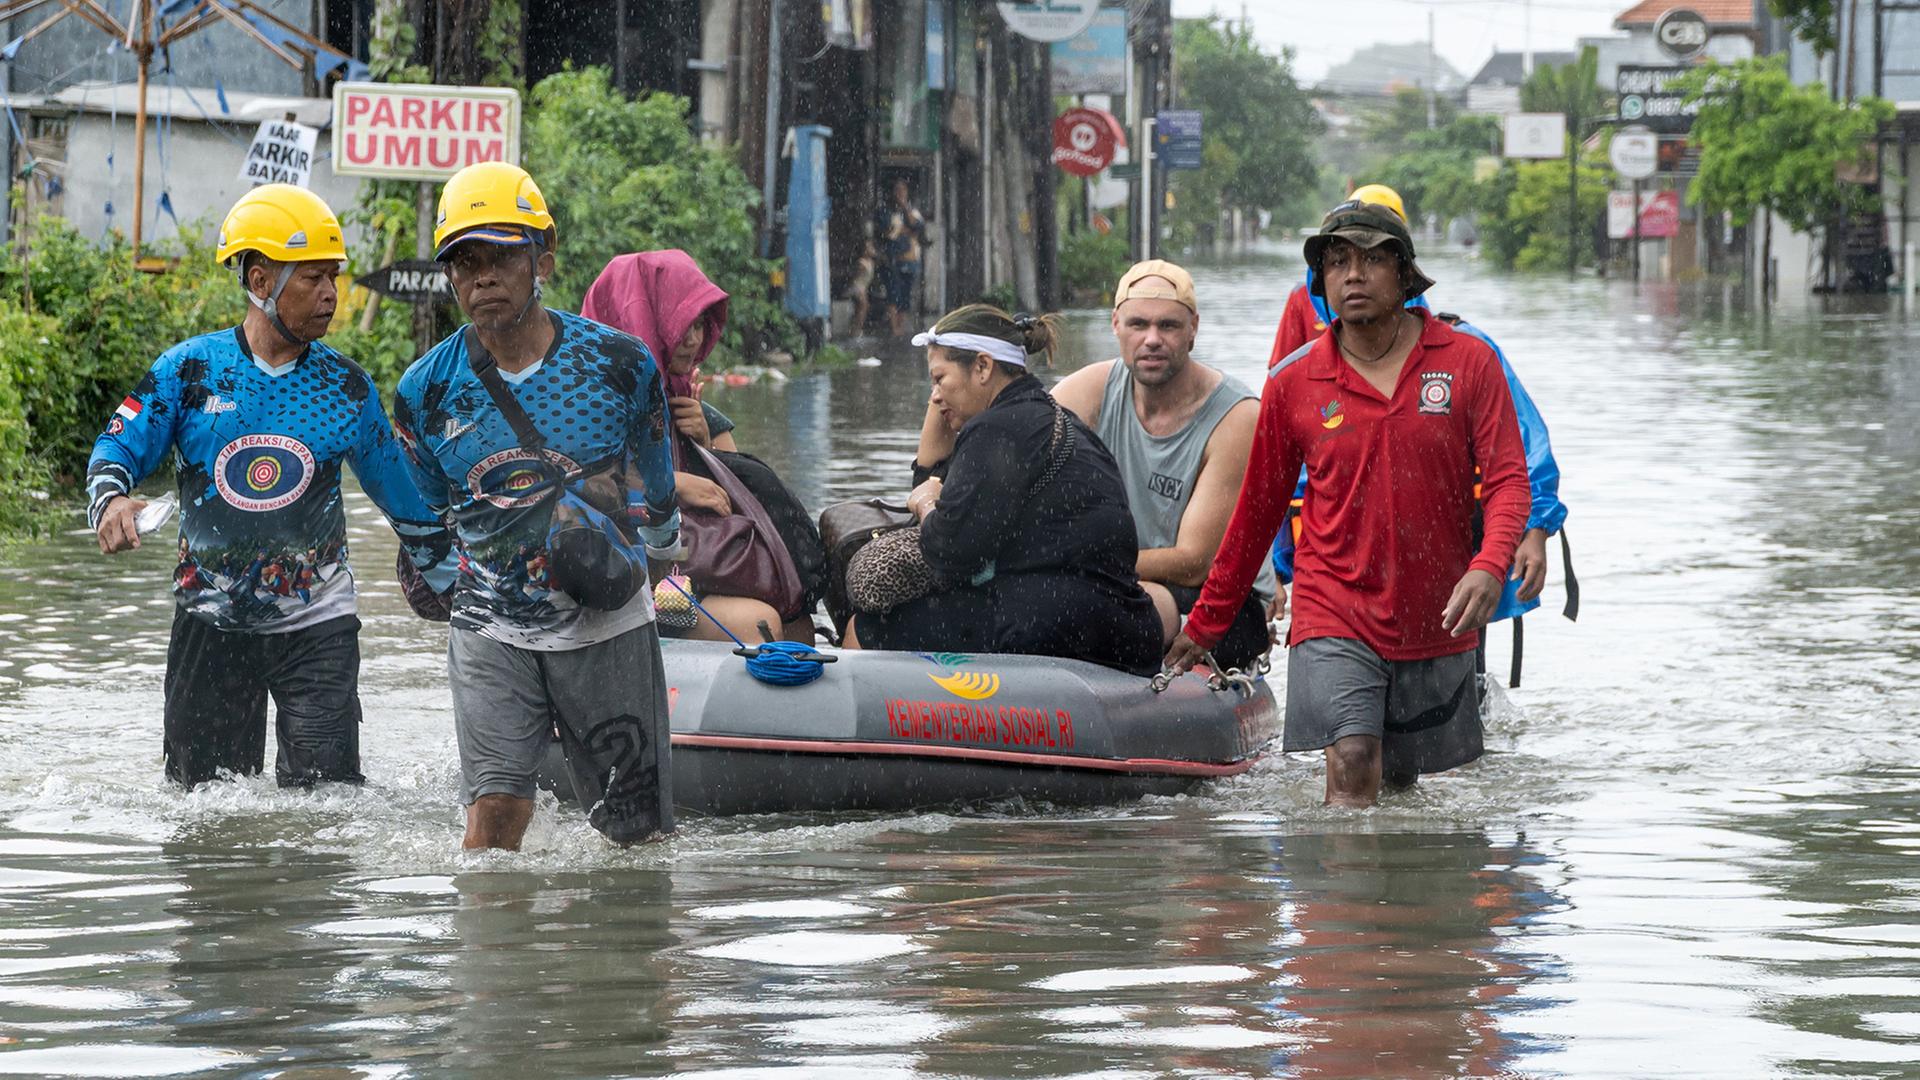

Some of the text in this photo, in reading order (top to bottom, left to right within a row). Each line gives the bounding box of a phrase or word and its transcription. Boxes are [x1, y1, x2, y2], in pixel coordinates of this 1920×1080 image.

[346, 95, 503, 133] PARKIR
[249, 142, 309, 171] PARKIR
[346, 133, 503, 168] UMUM
[247, 163, 299, 185] BAYAR
[388, 269, 449, 293] PARKIR
[1421, 372, 1453, 381] TAGANA
[221, 436, 314, 466] TIM REAKSI CEPAT
[468, 464, 486, 480] TIM
[259, 497, 290, 510] BENCANA
[885, 699, 1075, 748] KEMENTERIAN SOSIAL RI
